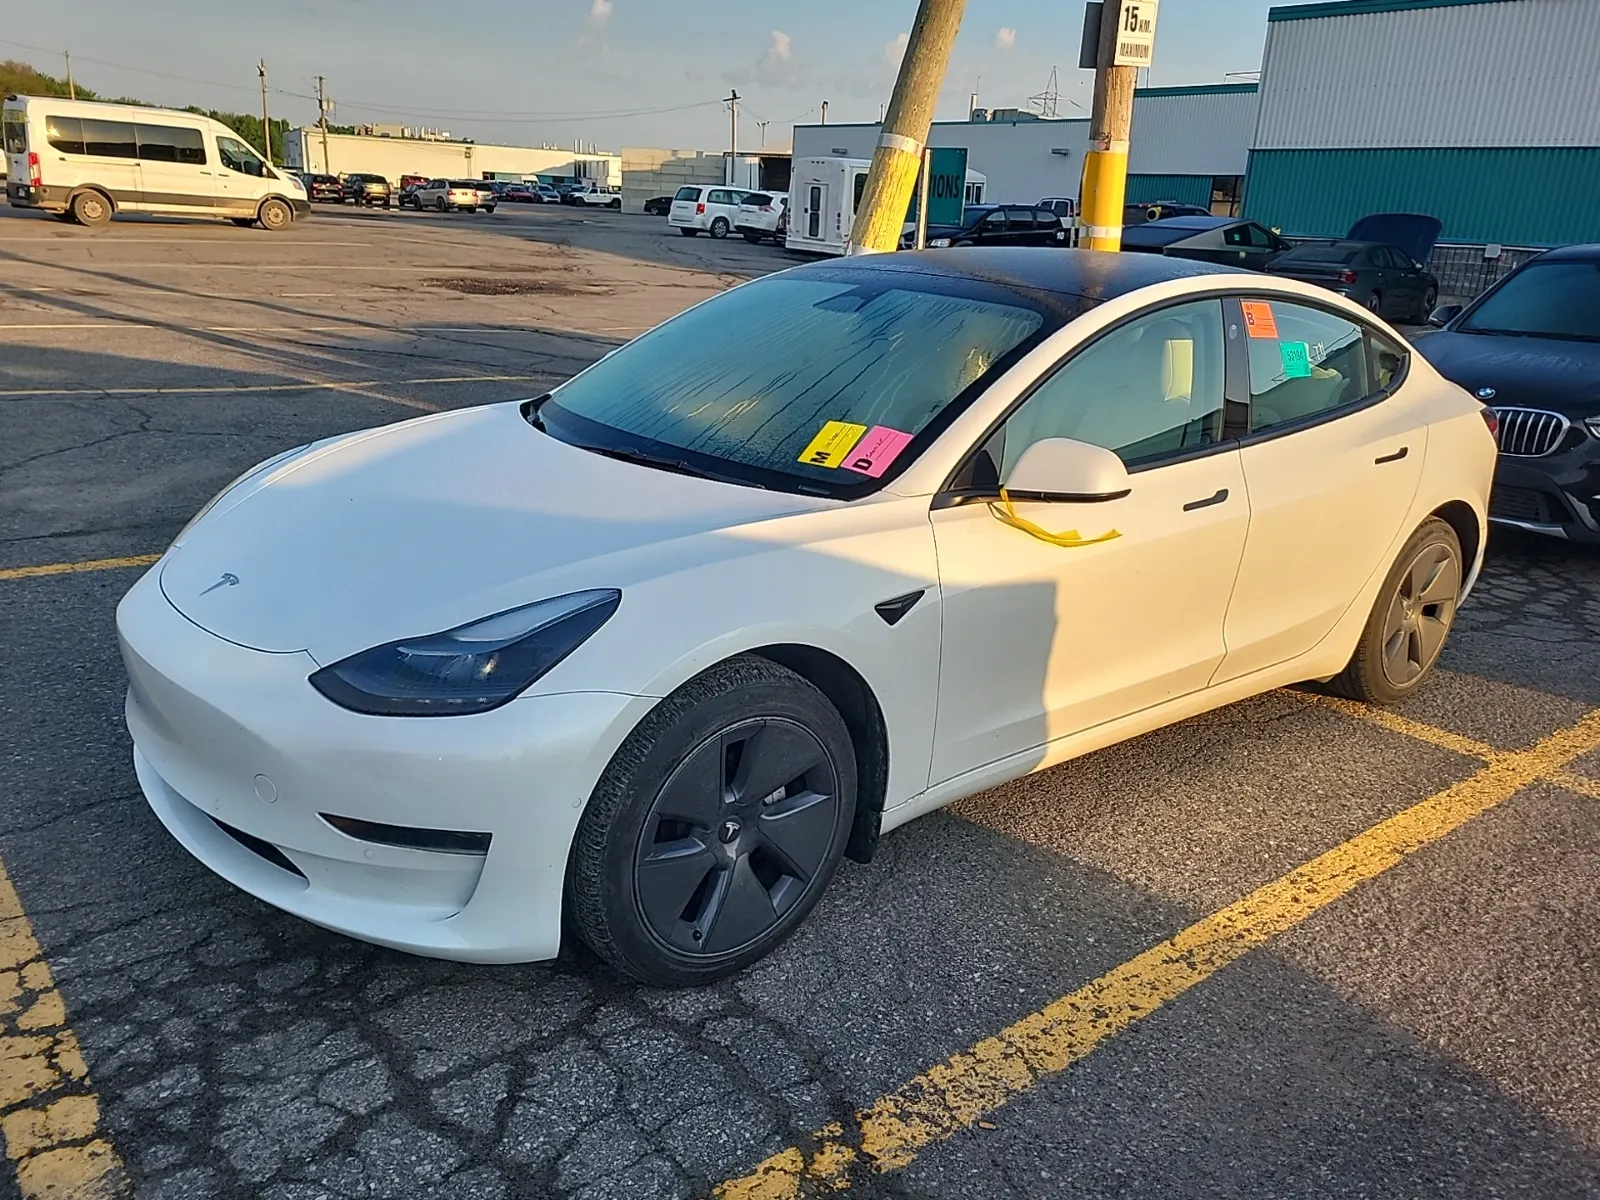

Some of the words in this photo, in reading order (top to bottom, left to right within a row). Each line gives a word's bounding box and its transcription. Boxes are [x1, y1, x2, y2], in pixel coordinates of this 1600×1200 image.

[1124, 5, 1140, 33] 15
[1119, 42, 1150, 58] MAXIMUM
[930, 174, 961, 199] IONS
[1056, 231, 1065, 240] 10
[1246, 311, 1255, 326] B
[809, 451, 831, 464] M
[852, 458, 873, 471] D
